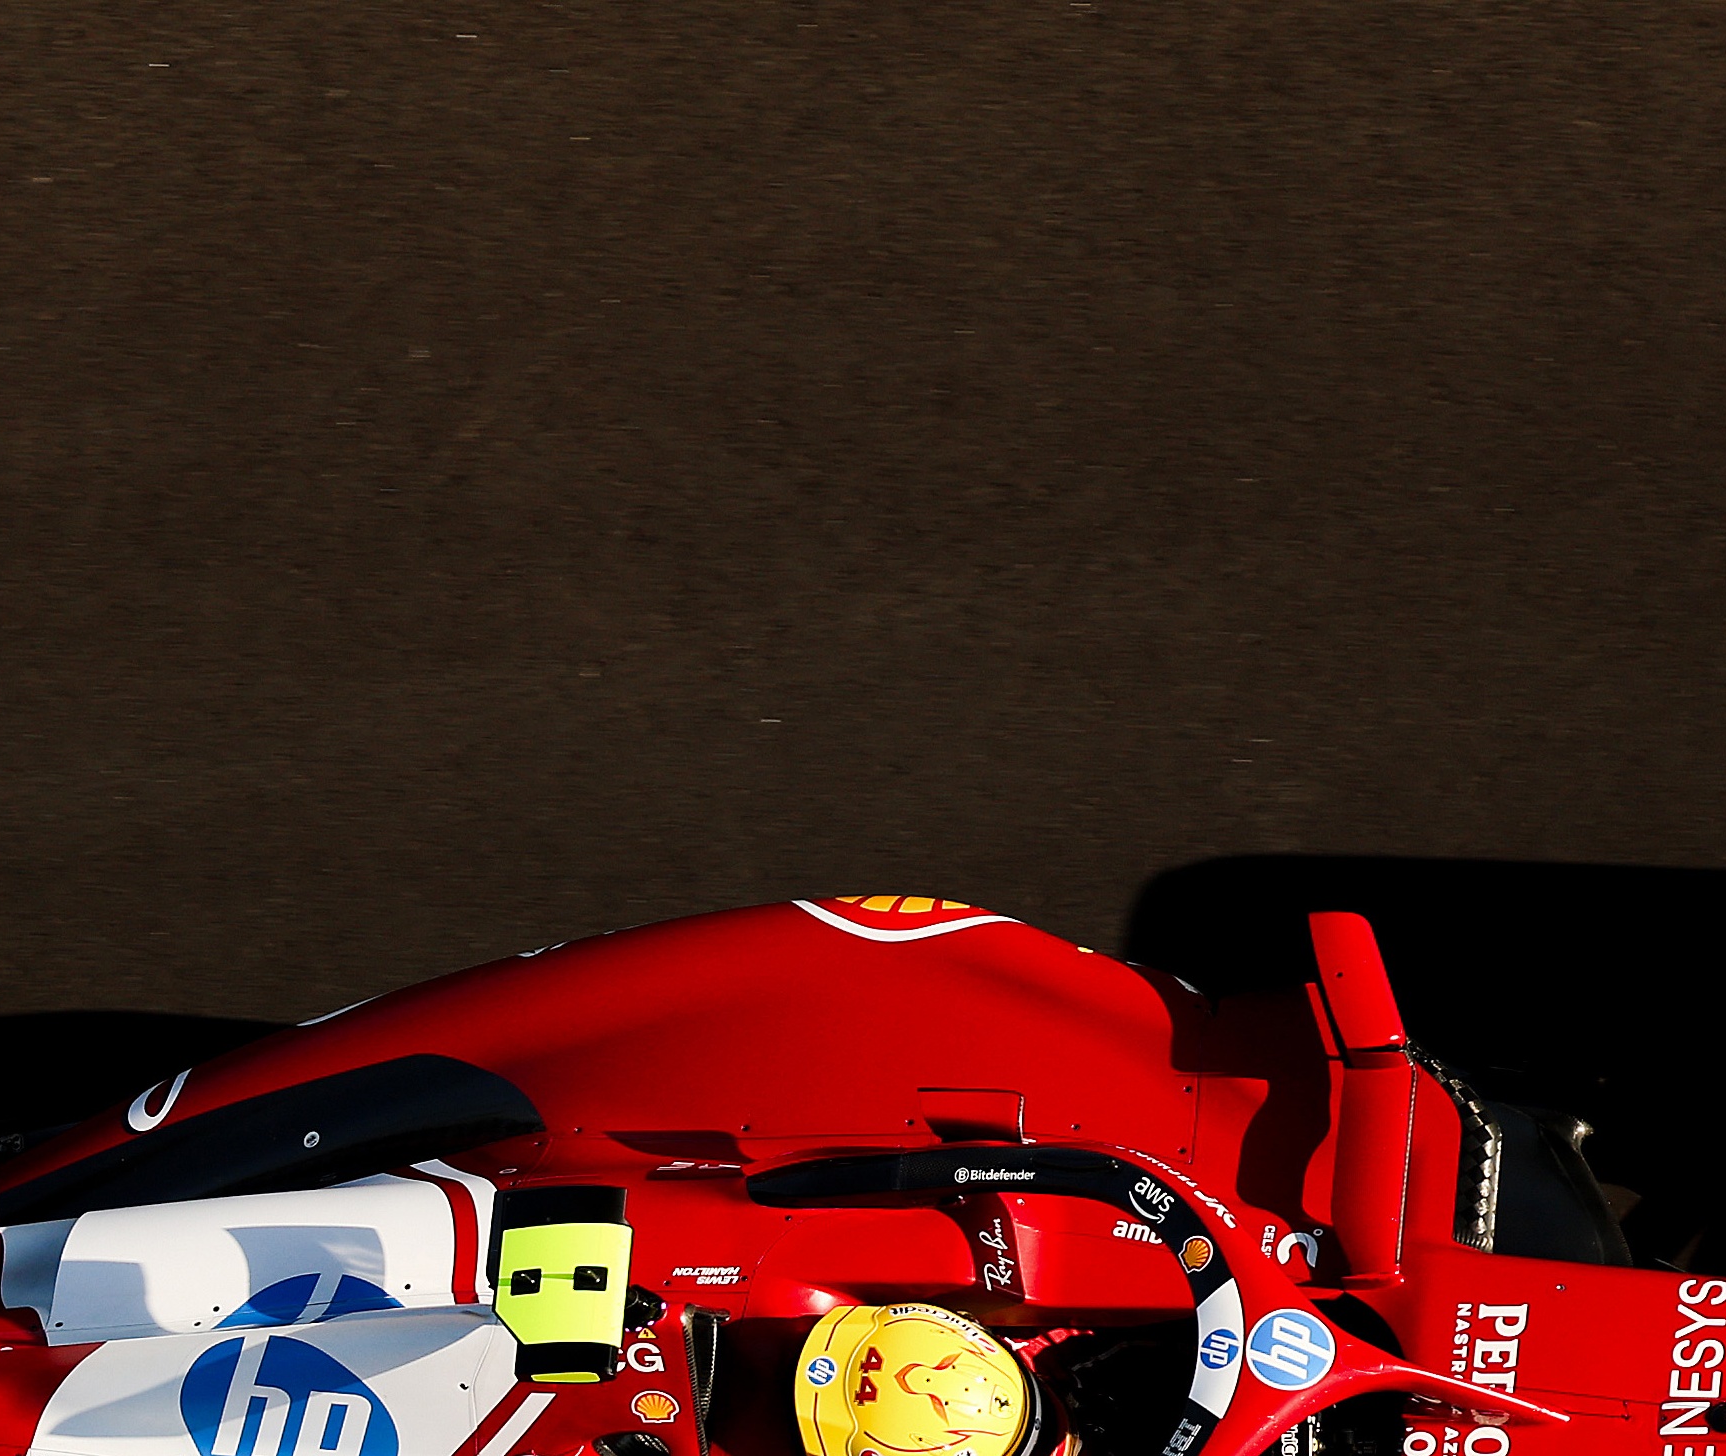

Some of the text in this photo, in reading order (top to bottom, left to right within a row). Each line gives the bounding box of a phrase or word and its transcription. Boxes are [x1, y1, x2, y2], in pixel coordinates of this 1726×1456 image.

[970, 1168, 1036, 1183] Bitdefender
[1134, 1176, 1175, 1213] aws
[672, 1267, 741, 1277] HAMILTON
[696, 1276, 740, 1285] LEWIS
[1201, 1330, 1239, 1368] hp
[1248, 1312, 1333, 1388] hp
[1451, 1303, 1473, 1381] NASTR
[807, 1357, 836, 1385] hp
[853, 1346, 884, 1406] 44
